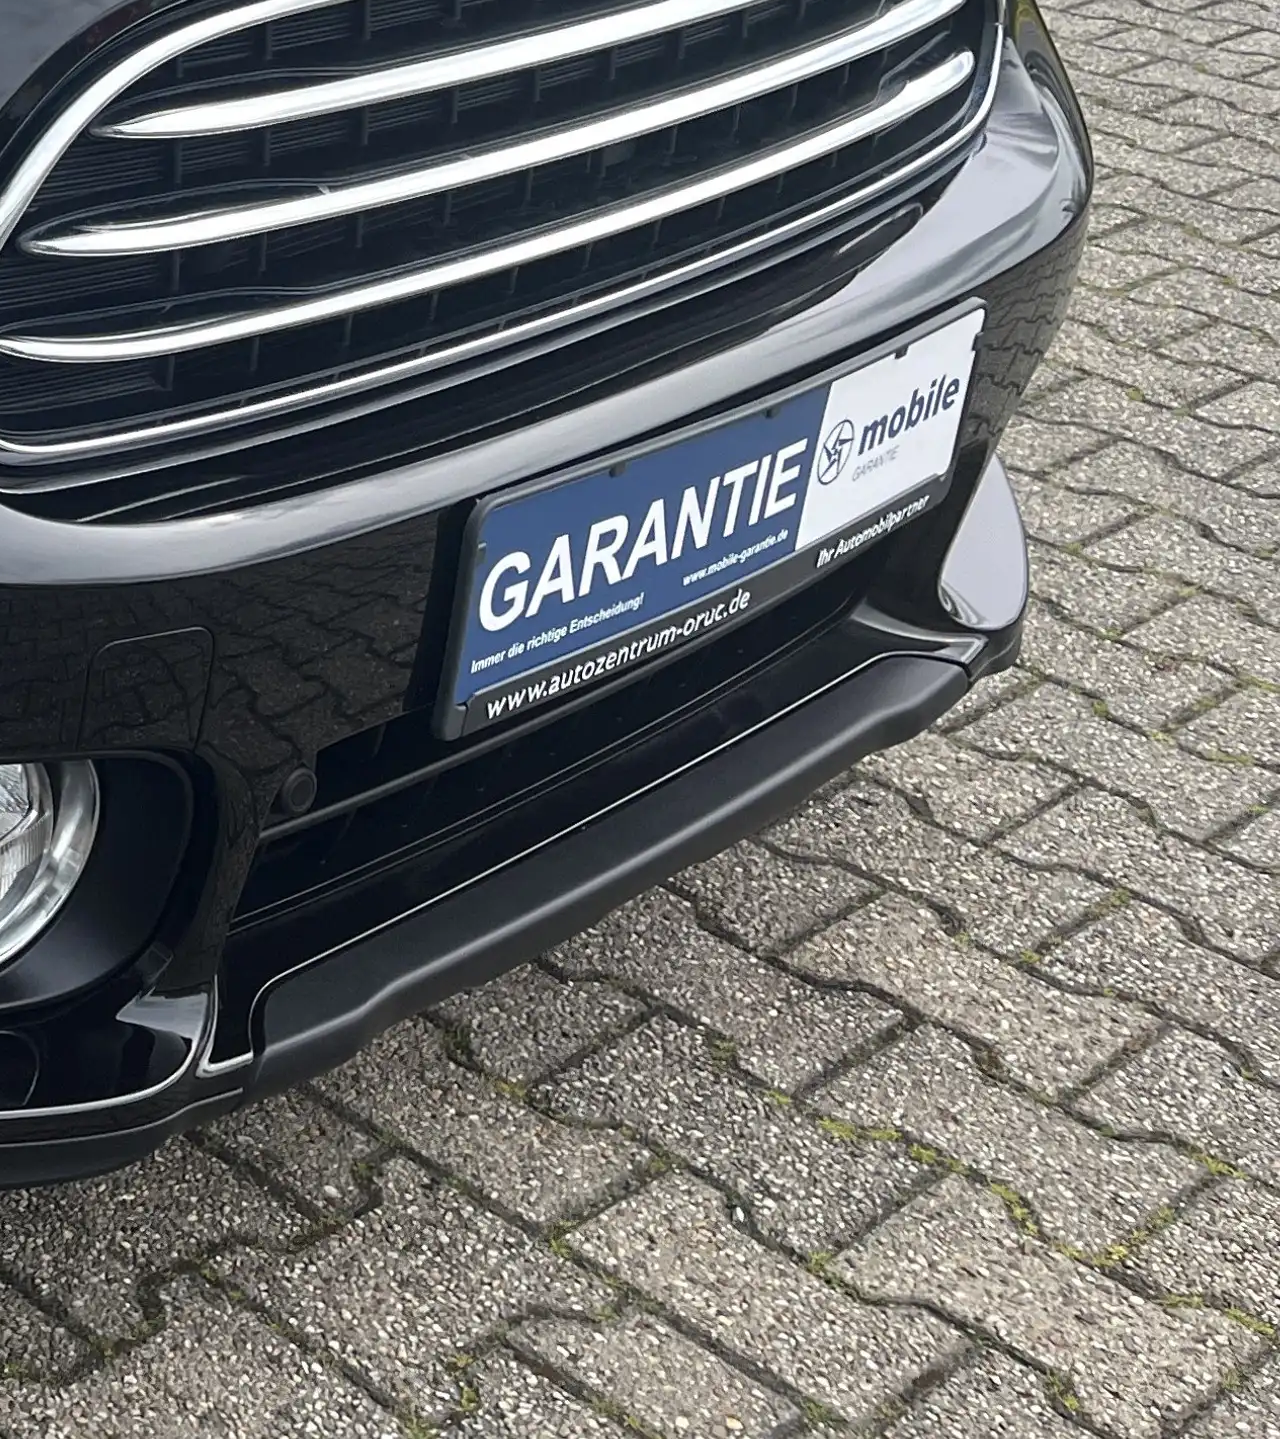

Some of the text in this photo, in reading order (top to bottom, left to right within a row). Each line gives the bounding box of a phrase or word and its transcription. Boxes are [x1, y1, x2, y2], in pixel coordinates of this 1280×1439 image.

[858, 374, 960, 456] mobile
[479, 438, 808, 632] GARANTIE
[682, 528, 789, 586] www.mobile-garantie.de
[816, 495, 930, 568] Ihr Automobilpartner
[470, 592, 645, 674] Immer die richtige Entscheidung!
[486, 587, 751, 720] www.autozentrum-oruc.de
